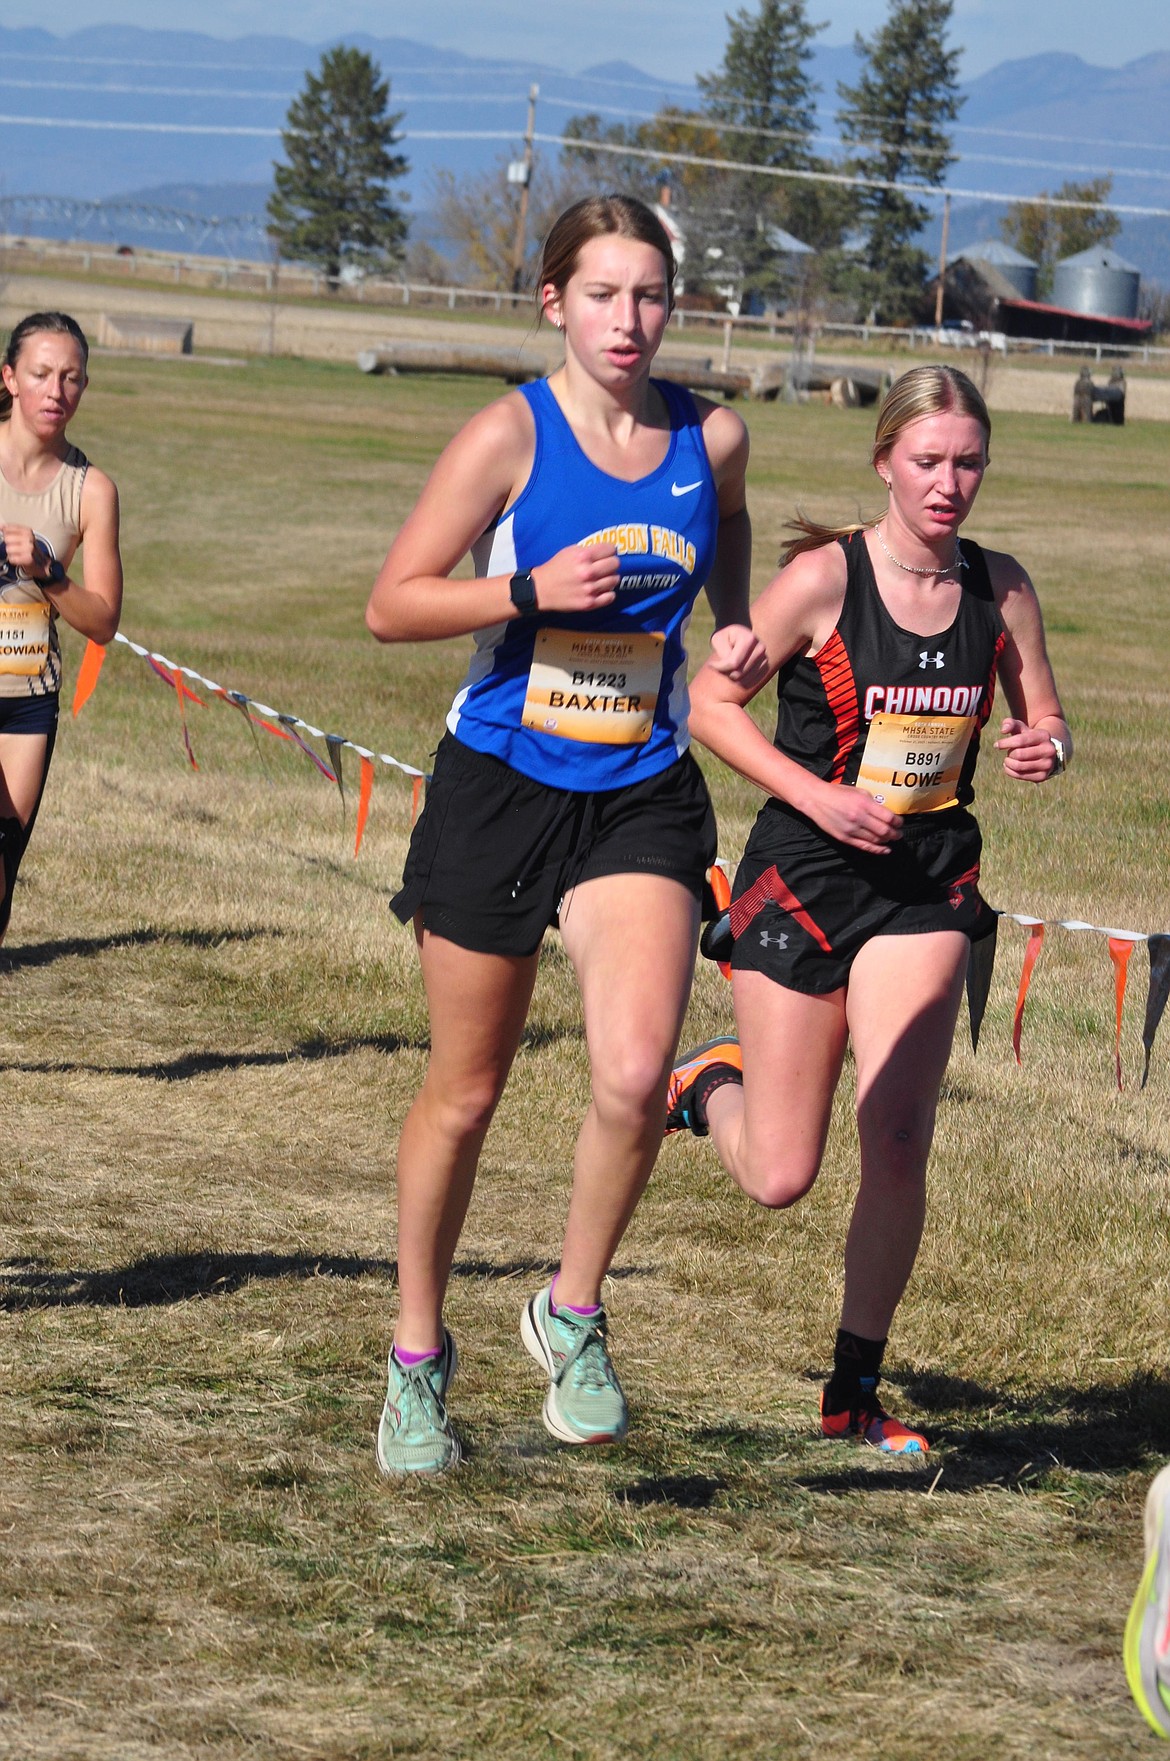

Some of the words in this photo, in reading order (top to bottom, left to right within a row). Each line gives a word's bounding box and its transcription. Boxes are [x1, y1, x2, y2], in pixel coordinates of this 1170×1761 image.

[650, 524, 697, 576] FALLS
[619, 573, 681, 591] COUNTRY
[604, 643, 634, 655] STATE
[571, 670, 627, 689] B1223
[548, 690, 642, 714] BAXTER
[902, 726, 927, 735] MHSA
[929, 727, 955, 736] STATE
[905, 752, 941, 766] B891
[891, 771, 945, 788] LOWE
